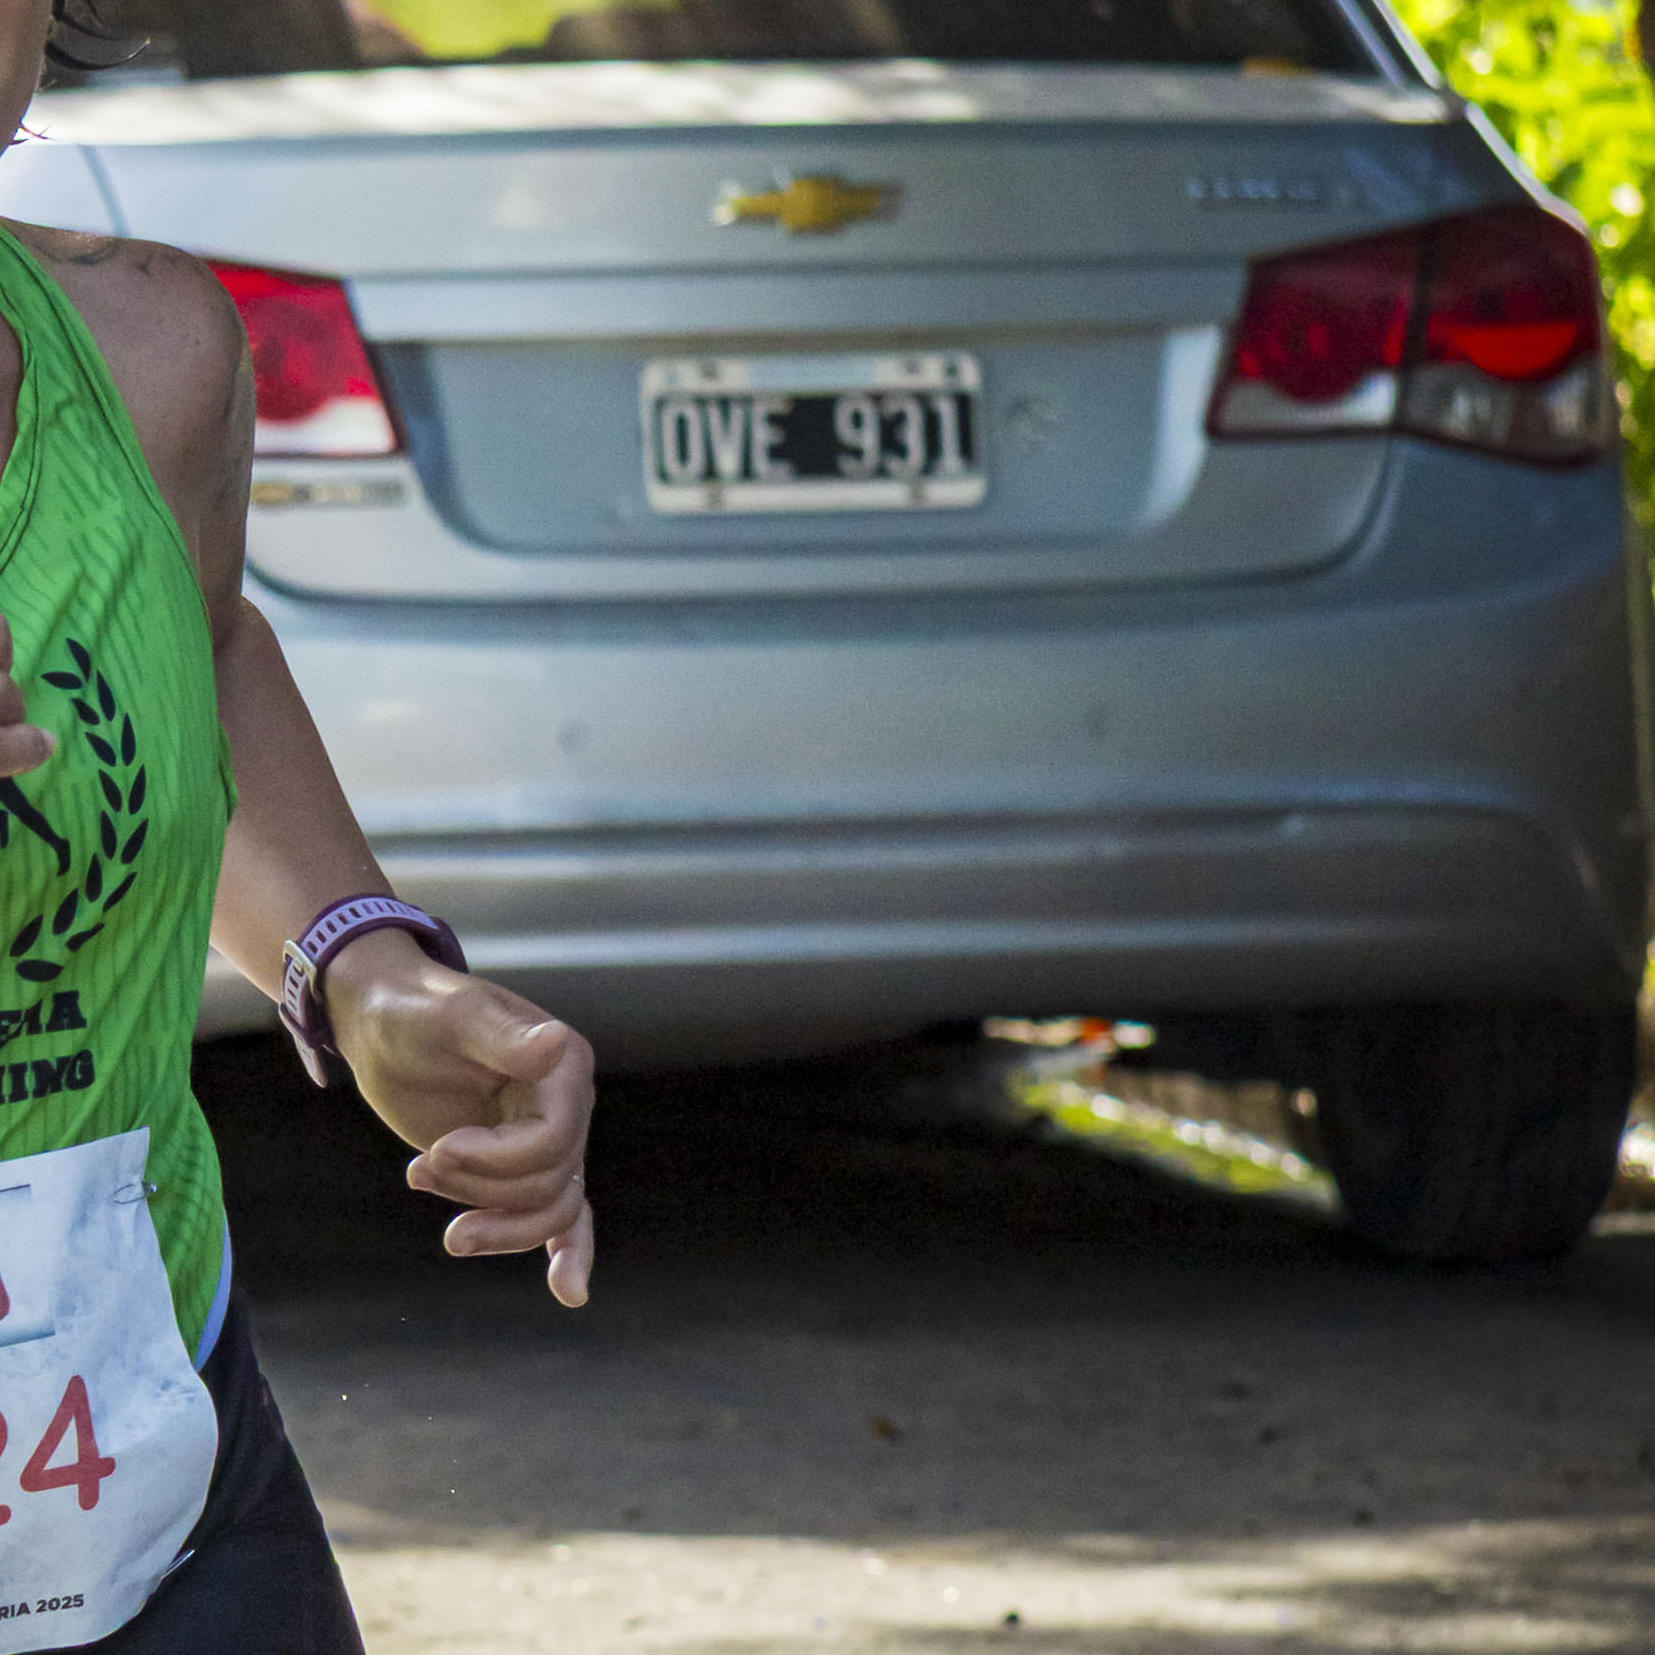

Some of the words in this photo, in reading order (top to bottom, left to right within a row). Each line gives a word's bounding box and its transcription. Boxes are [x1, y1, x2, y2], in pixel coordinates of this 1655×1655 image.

[661, 396, 797, 483] OVE
[834, 392, 970, 480] 931
[36, 1594, 85, 1613] 2025
